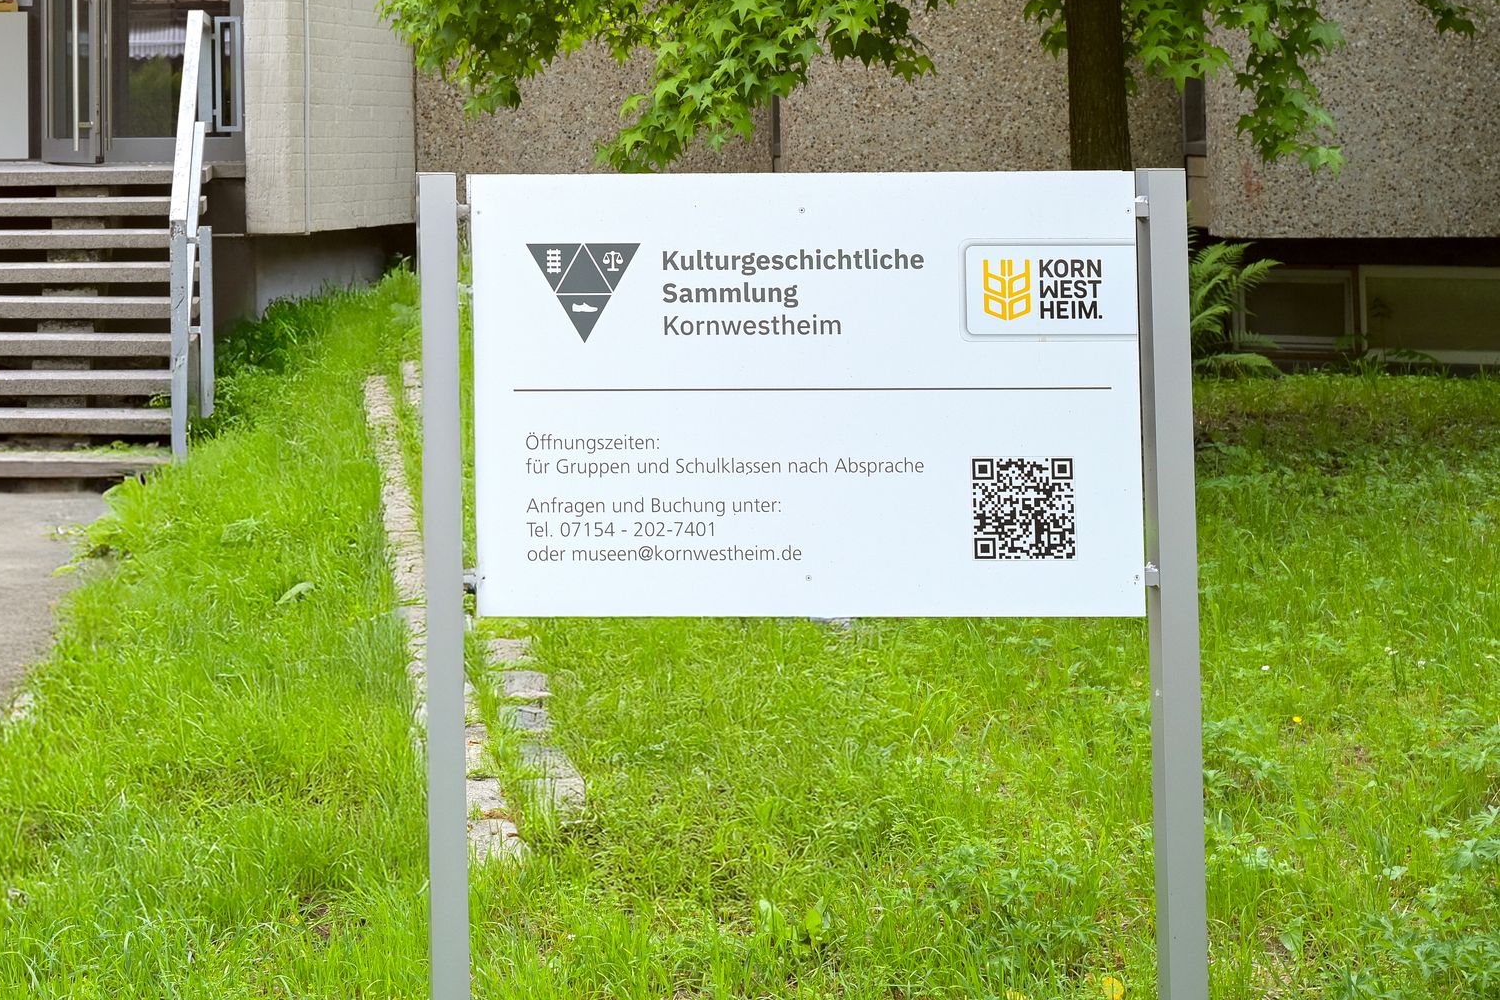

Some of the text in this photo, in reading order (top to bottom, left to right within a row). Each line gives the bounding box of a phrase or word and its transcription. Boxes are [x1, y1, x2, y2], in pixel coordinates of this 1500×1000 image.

[662, 248, 925, 276] Kulturgeschichtliche
[1038, 258, 1102, 279] KORN
[662, 281, 799, 309] Sammlung
[1039, 279, 1103, 299] WEST
[1039, 300, 1104, 320] HEIM.
[663, 313, 842, 336] Kornwestheim
[525, 431, 660, 455] Öffnungszeiten:
[525, 457, 925, 478] für Gruppen und Schulklassen nach Absprache
[526, 496, 782, 518] Anfragen und Buchung unter:
[526, 521, 553, 538] Tel.
[560, 521, 616, 538] 07154
[633, 521, 716, 538] 202-7401
[527, 544, 803, 562] oder museen@kornwestheim.de
